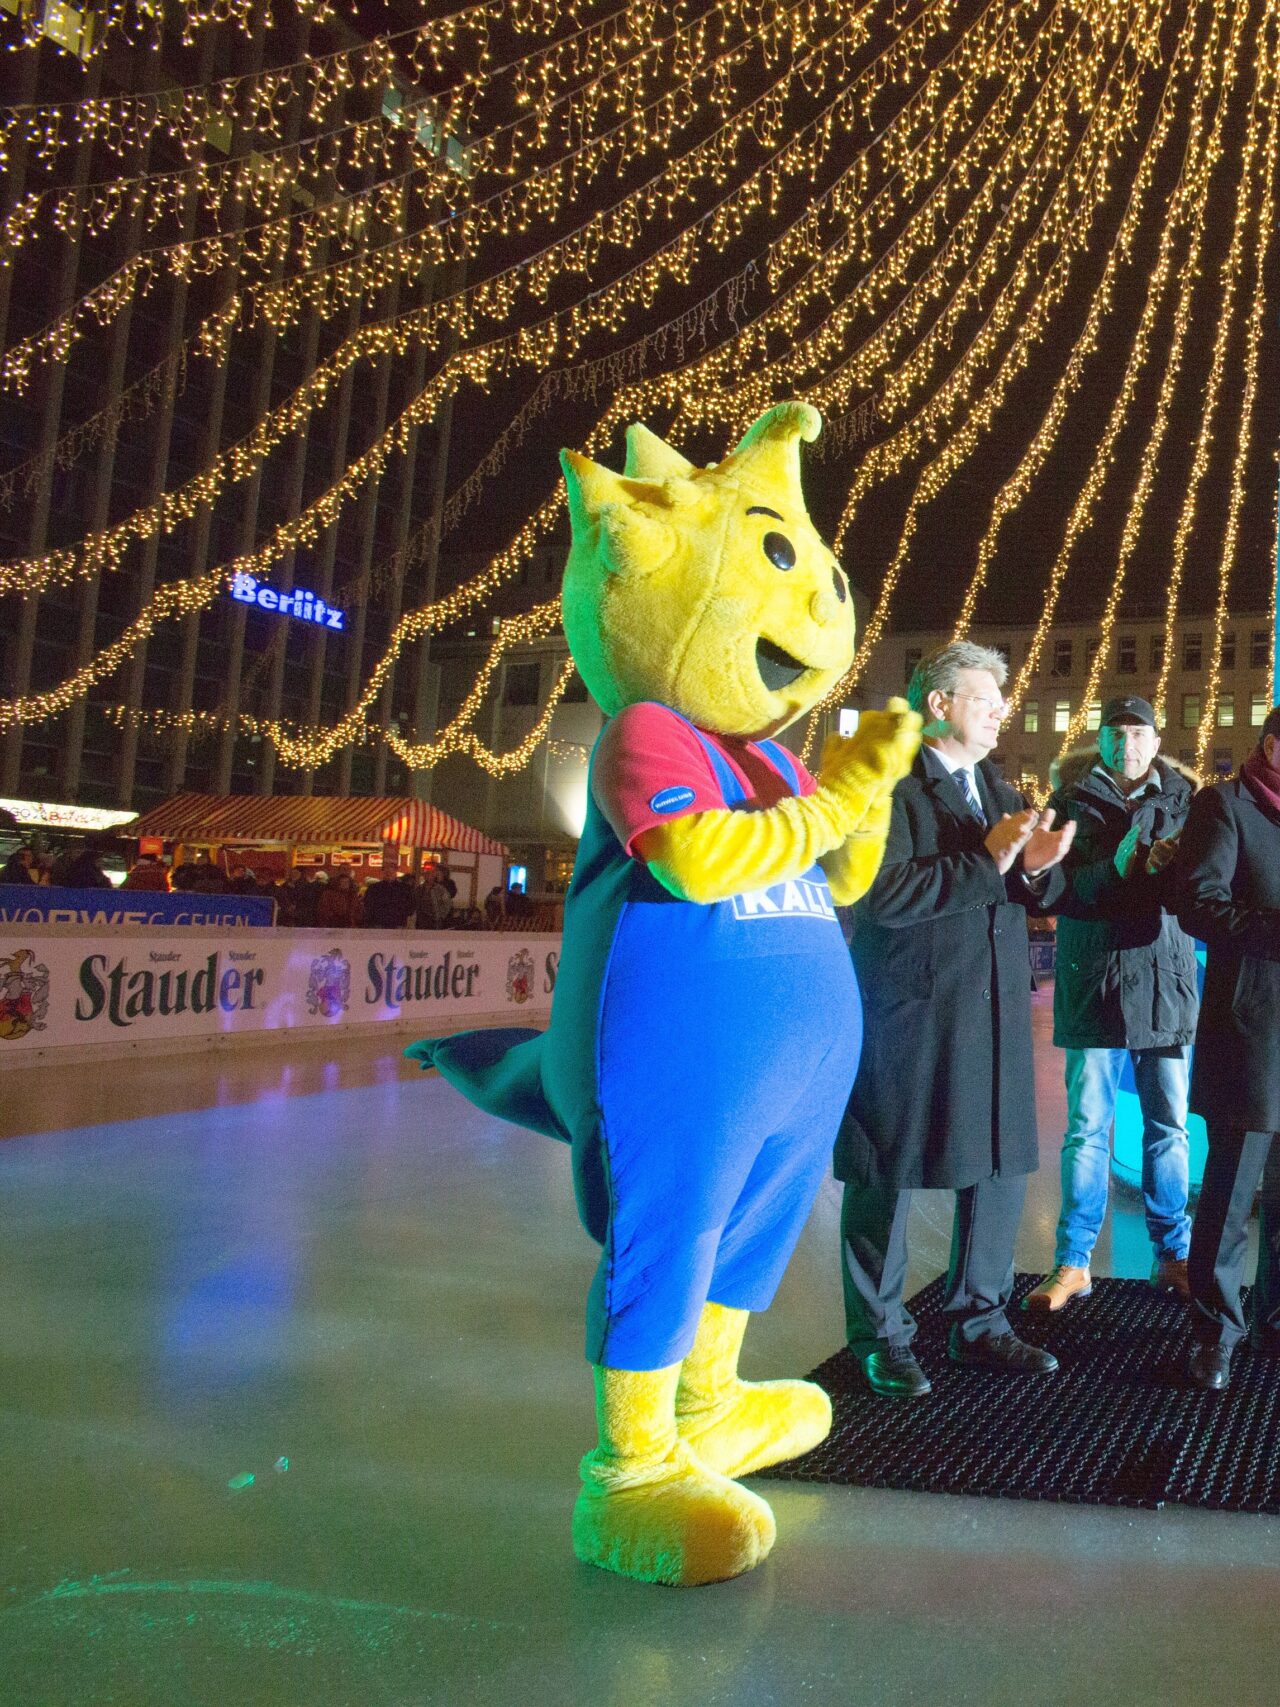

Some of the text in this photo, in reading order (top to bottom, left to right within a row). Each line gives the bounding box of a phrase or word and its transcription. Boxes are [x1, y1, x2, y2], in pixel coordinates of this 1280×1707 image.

[232, 573, 343, 630] Berlitz
[75, 950, 264, 1027] Stauder
[364, 950, 480, 1010] Stauder
